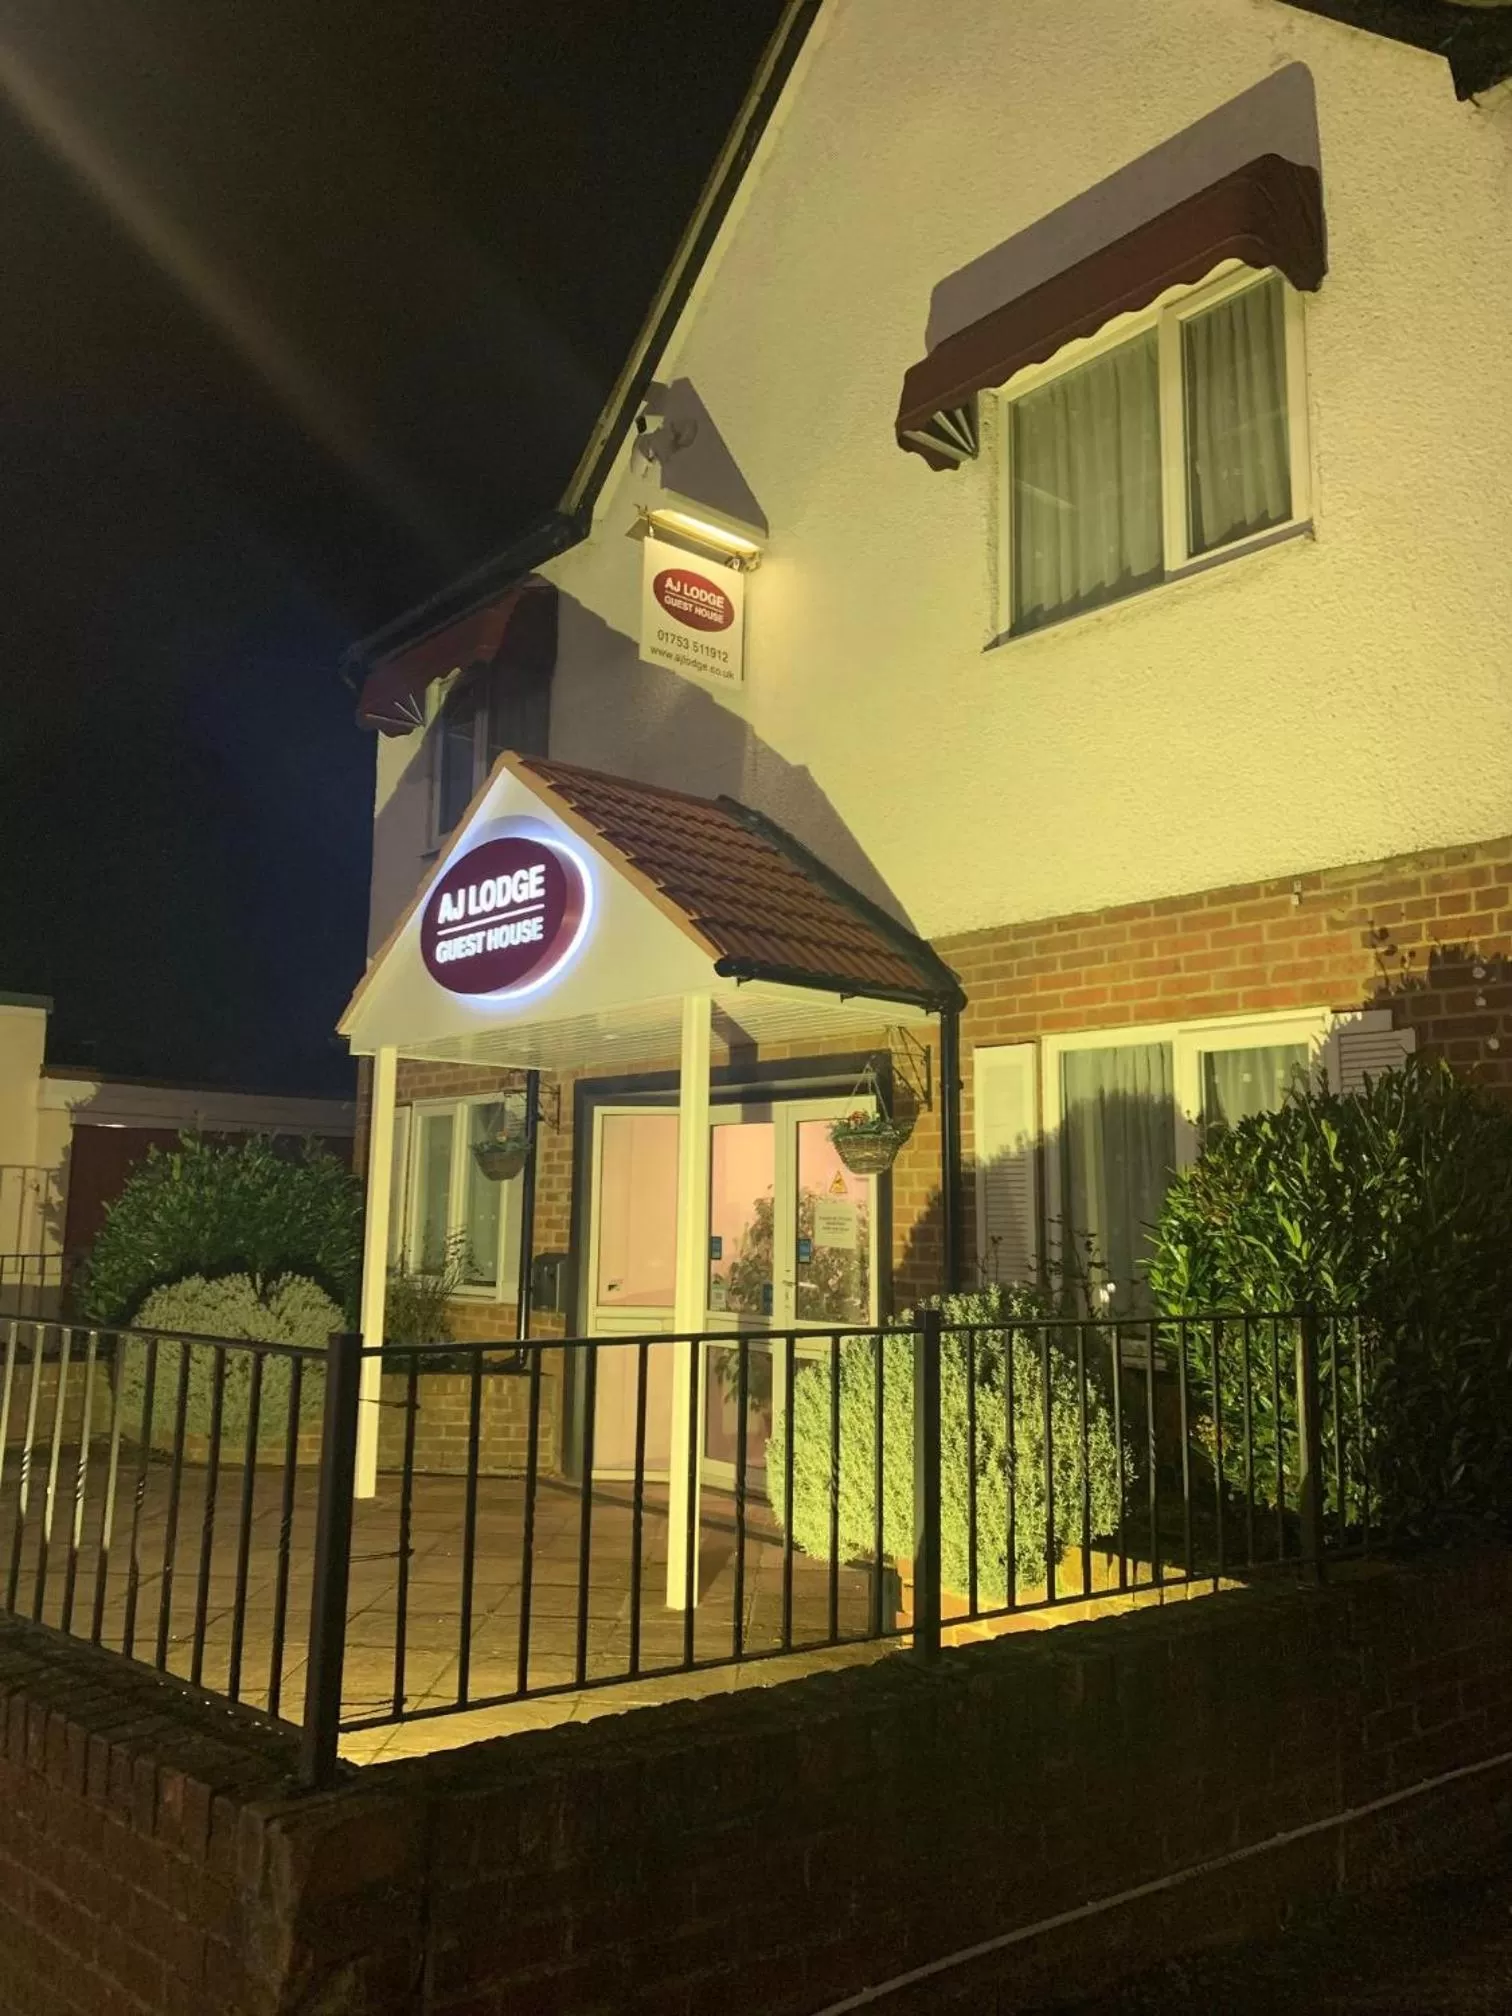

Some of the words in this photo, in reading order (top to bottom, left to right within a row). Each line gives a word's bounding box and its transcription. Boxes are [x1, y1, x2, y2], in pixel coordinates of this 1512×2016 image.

[664, 595, 693, 613] GUEST
[694, 607, 725, 624] HOUSE
[665, 577, 681, 592] AJ
[684, 583, 725, 608] LODGE
[649, 646, 735, 680] www.ajlodge.co.uk
[657, 629, 690, 650] 01753
[693, 642, 729, 663] 511912
[437, 888, 466, 924] AJ
[468, 864, 546, 915] LODGE
[435, 931, 486, 963] GUEST
[486, 917, 544, 951] HOUSE
